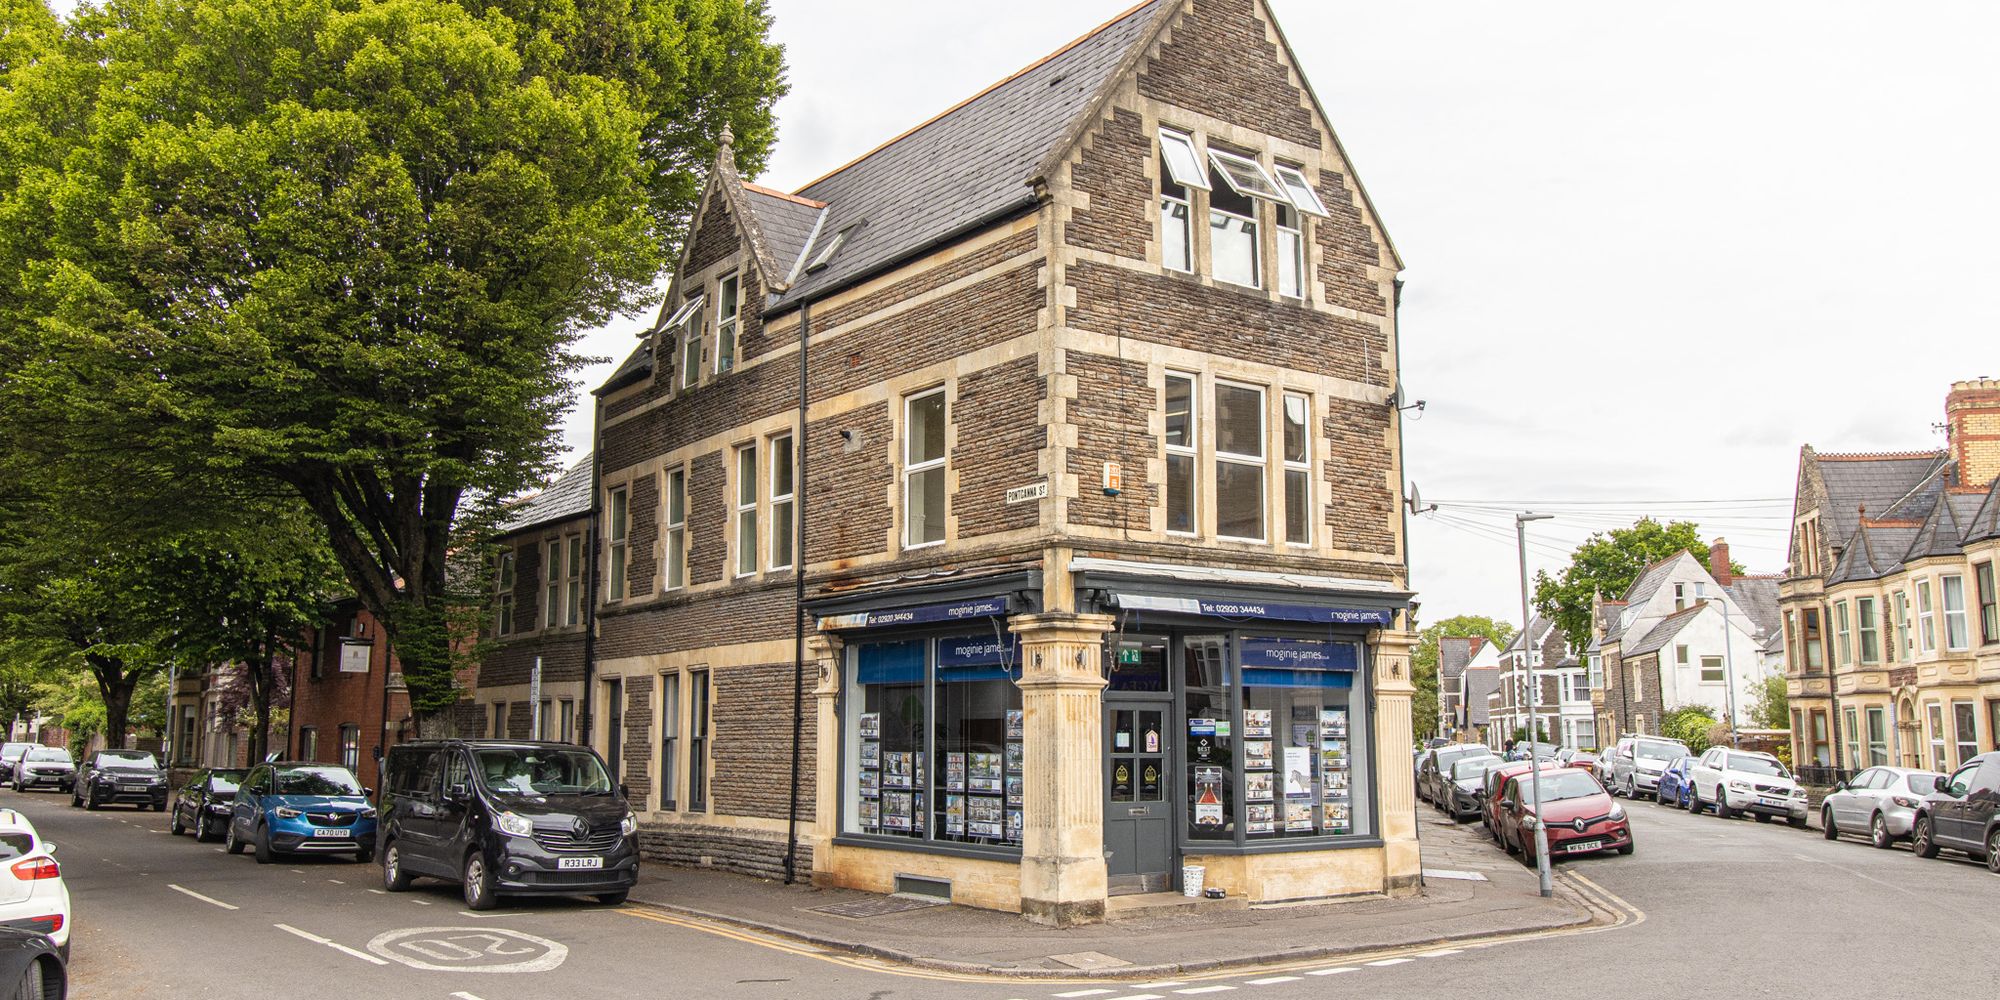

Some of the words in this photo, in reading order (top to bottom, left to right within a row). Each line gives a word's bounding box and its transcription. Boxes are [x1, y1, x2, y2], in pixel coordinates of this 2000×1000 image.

[1008, 487, 1037, 501] PONTCANNA
[948, 603, 973, 618] moginie
[1201, 603, 1215, 613] Tel:
[1216, 604, 1239, 614] 02920
[1239, 605, 1265, 615] 344434
[1331, 609, 1359, 622] moginie
[868, 615, 878, 624] Tel:
[878, 613, 894, 624] 02920
[894, 612, 914, 622] 344434
[955, 642, 983, 658] moginie
[1266, 648, 1298, 661] moginie
[564, 859, 580, 867] R33
[581, 859, 598, 867] LRJ
